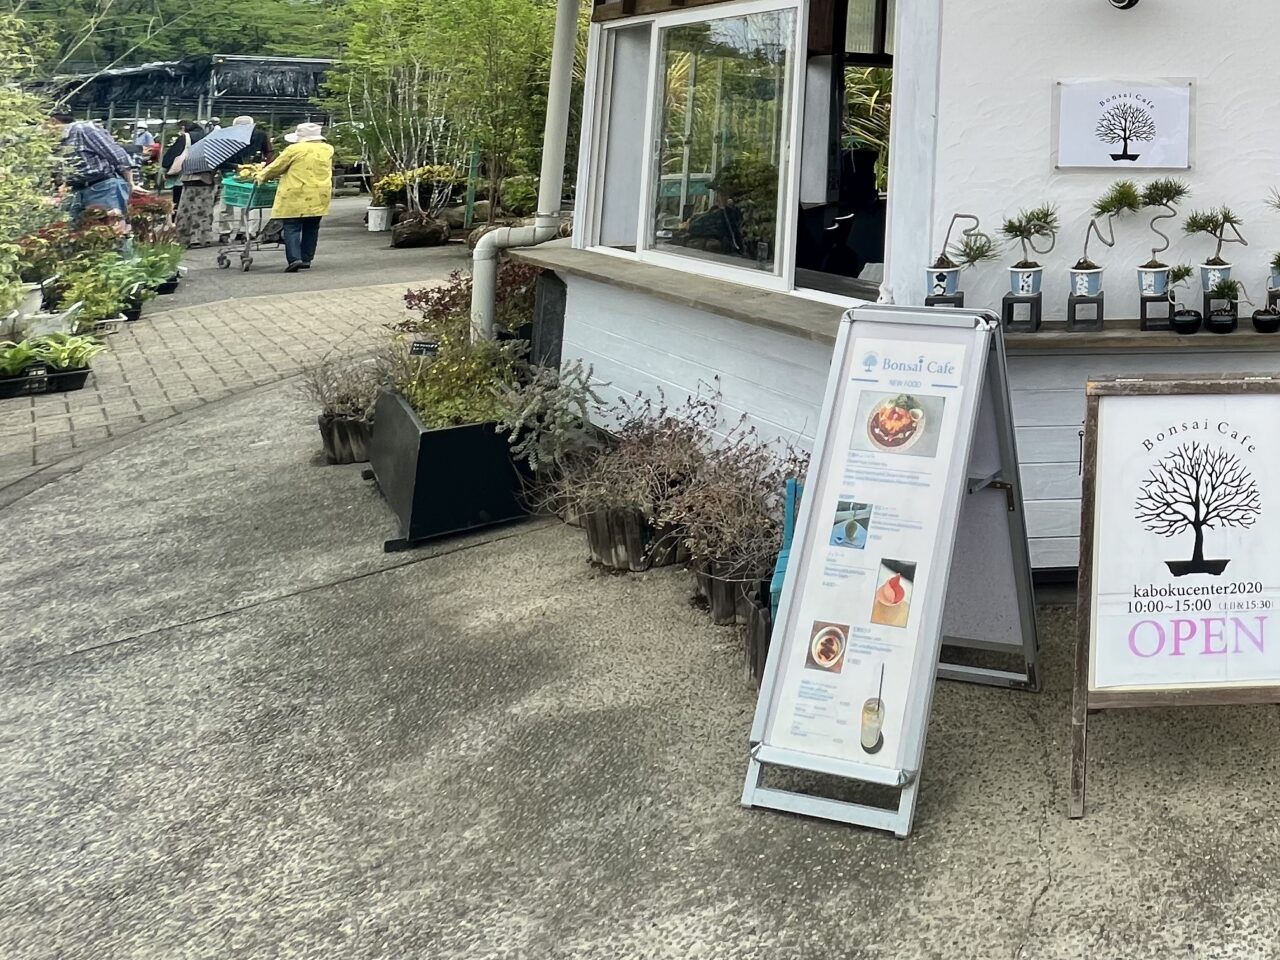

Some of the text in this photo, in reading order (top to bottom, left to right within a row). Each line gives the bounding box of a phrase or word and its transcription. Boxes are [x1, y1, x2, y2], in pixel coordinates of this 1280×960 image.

[1099, 93, 1155, 109] Bonsai Cafe
[882, 356, 922, 372] Bonsai
[1142, 418, 1256, 453] Bonsai Cafe
[1133, 582, 1263, 598] kabokucenter2020
[1128, 615, 1269, 658] OPEN
